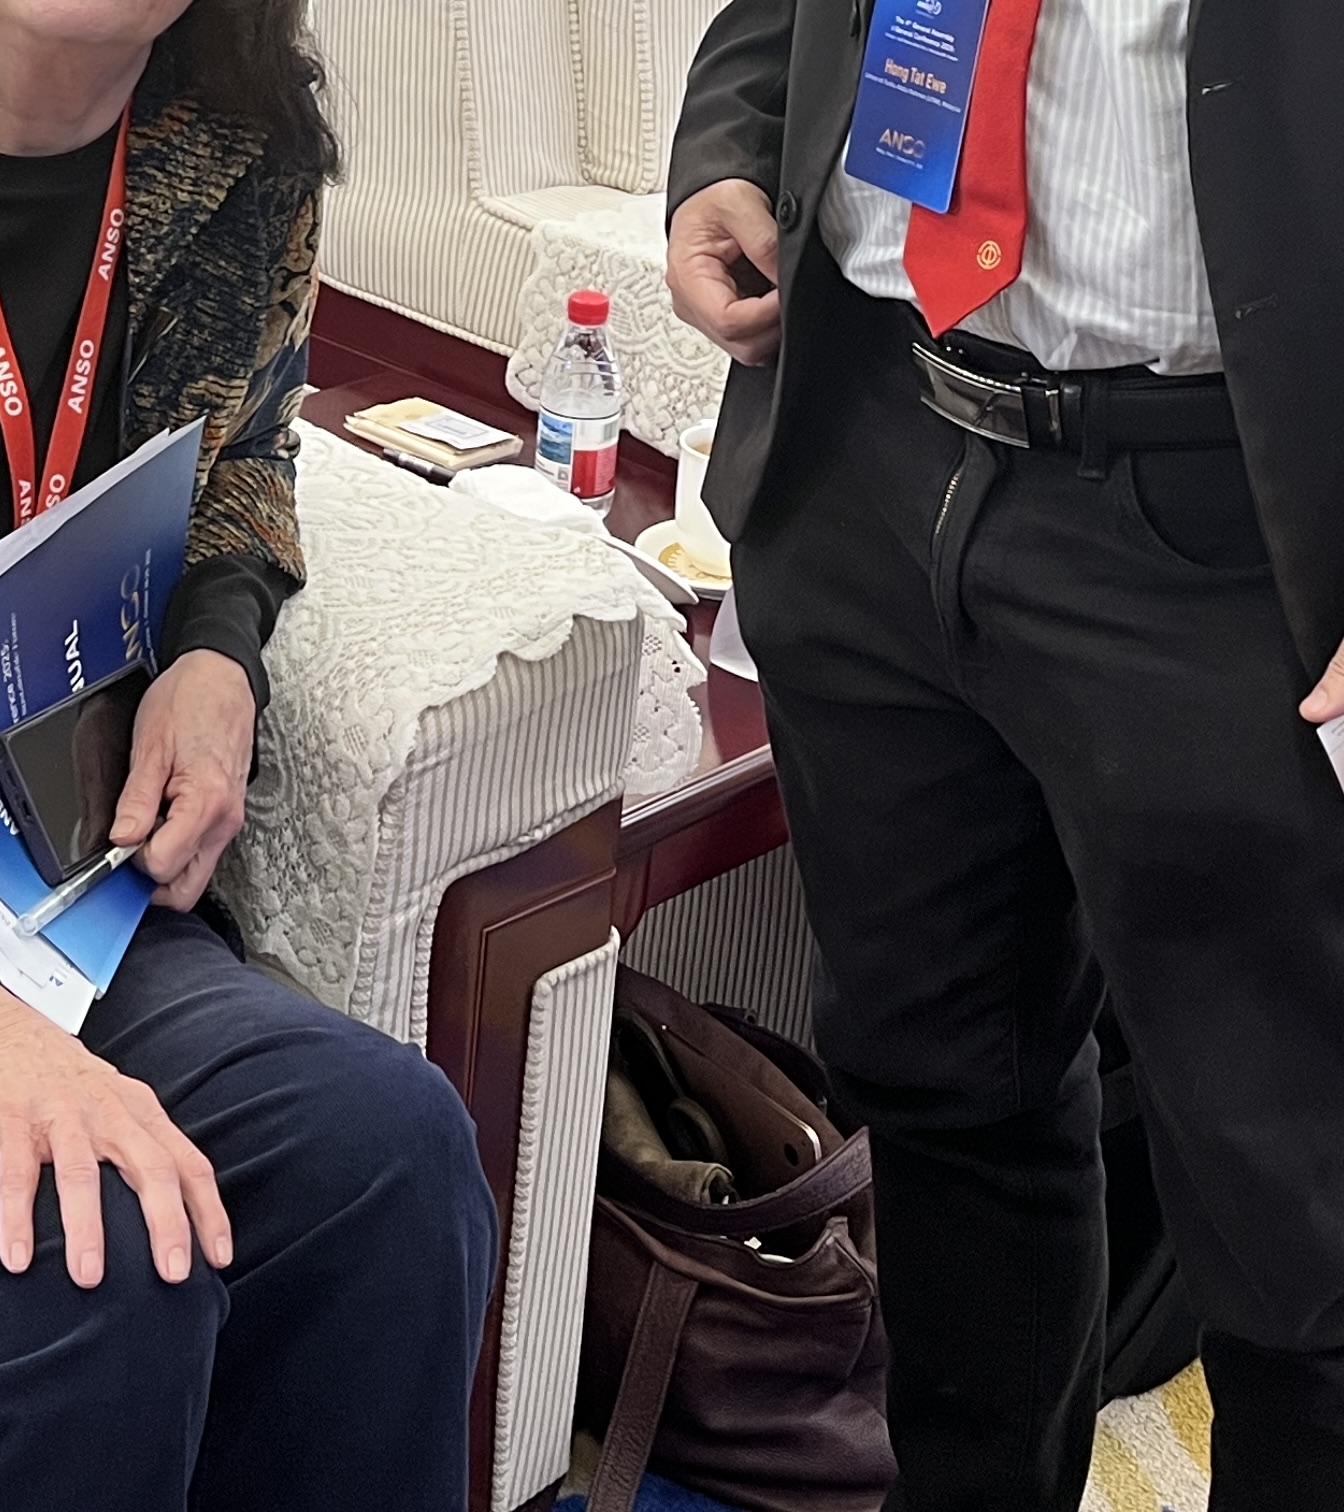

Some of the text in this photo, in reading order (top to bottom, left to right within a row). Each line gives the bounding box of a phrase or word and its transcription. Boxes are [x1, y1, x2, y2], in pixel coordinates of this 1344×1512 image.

[884, 58, 909, 84] Hong
[910, 67, 926, 86] Tat
[925, 73, 947, 94] Ewe
[879, 128, 926, 159] ANSO
[98, 208, 125, 281] ANSO
[67, 339, 94, 414] ANSO
[18, 479, 34, 527] AN
[46, 473, 66, 508] SO
[121, 563, 143, 661] NSO
[64, 619, 85, 693] NUAL
[7, 683, 19, 724] rence
